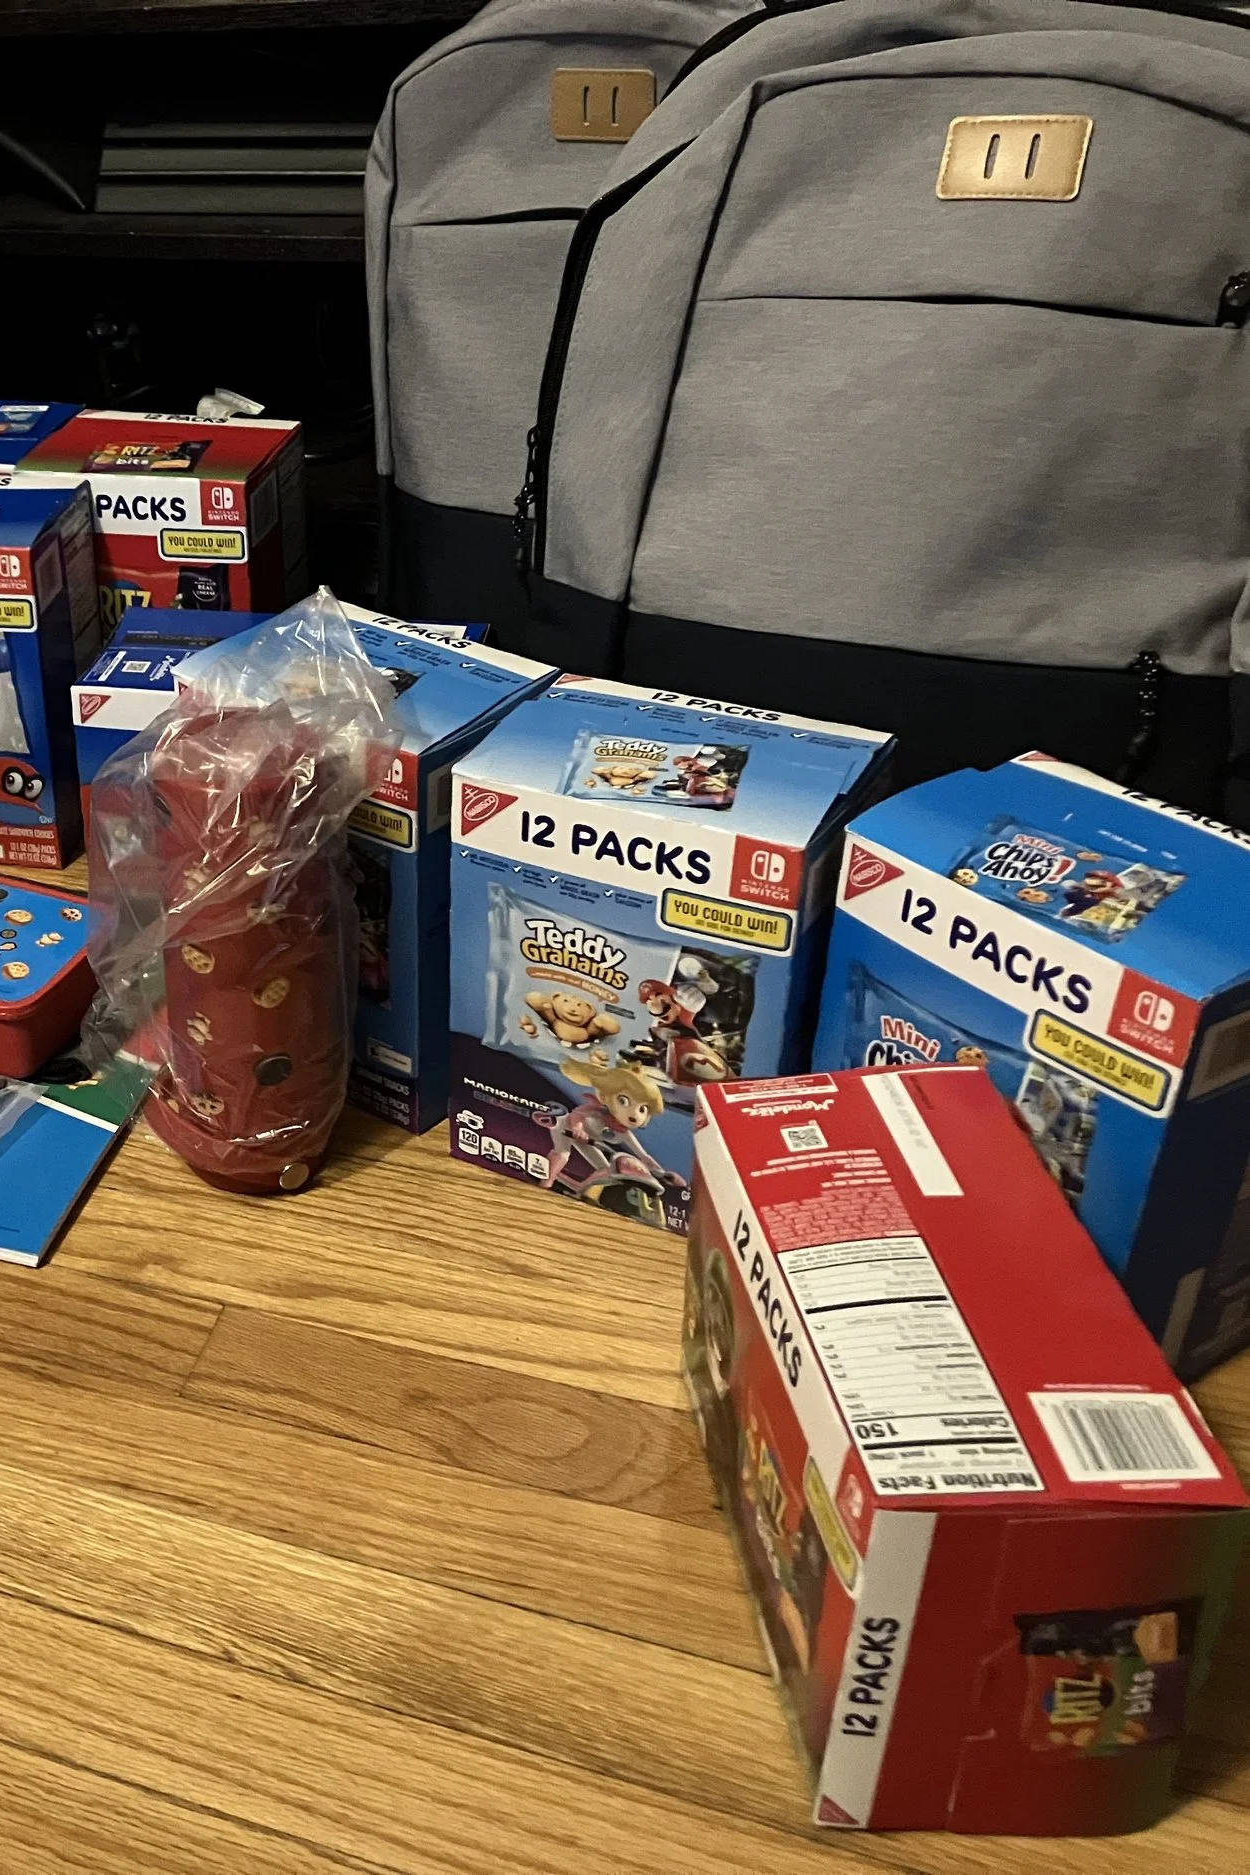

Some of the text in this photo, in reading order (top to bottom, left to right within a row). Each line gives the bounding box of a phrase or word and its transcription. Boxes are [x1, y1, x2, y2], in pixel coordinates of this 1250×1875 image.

[116, 457, 149, 466] bits
[96, 494, 187, 522] PACKS
[208, 513, 240, 522] SWITCH
[168, 536, 185, 548] YOU
[187, 537, 214, 549] COULD
[372, 616, 399, 626] 12
[397, 624, 473, 649] PACKS
[651, 692, 685, 705] 12
[686, 699, 782, 723] PACKS
[594, 746, 667, 763] Grahams
[600, 739, 668, 755] Teddy
[466, 795, 496, 817] NABISCO
[521, 811, 711, 885] 12 PACKS
[987, 843, 1058, 868] Chips
[982, 859, 1074, 885] Ahoy!
[740, 884, 790, 902] SWITCH
[674, 900, 699, 916] YOU
[702, 907, 743, 927] COULD
[525, 920, 626, 969] Teddy
[900, 888, 1094, 1015] 12 PACKS
[521, 938, 629, 990] Grahams
[881, 1015, 940, 1061] Mini
[1044, 1024, 1071, 1047] YOU
[1074, 1040, 1118, 1070] COULD
[461, 1130, 478, 1144] 120
[668, 1216, 683, 1228] NET
[733, 1209, 802, 1388] 12 PACKS
[855, 1415, 1009, 1440] Calories 150
[877, 1473, 1037, 1491] Nutrition Facts
[841, 1616, 900, 1737] 12 PACKS
[1050, 1673, 1103, 1725] RITZ
